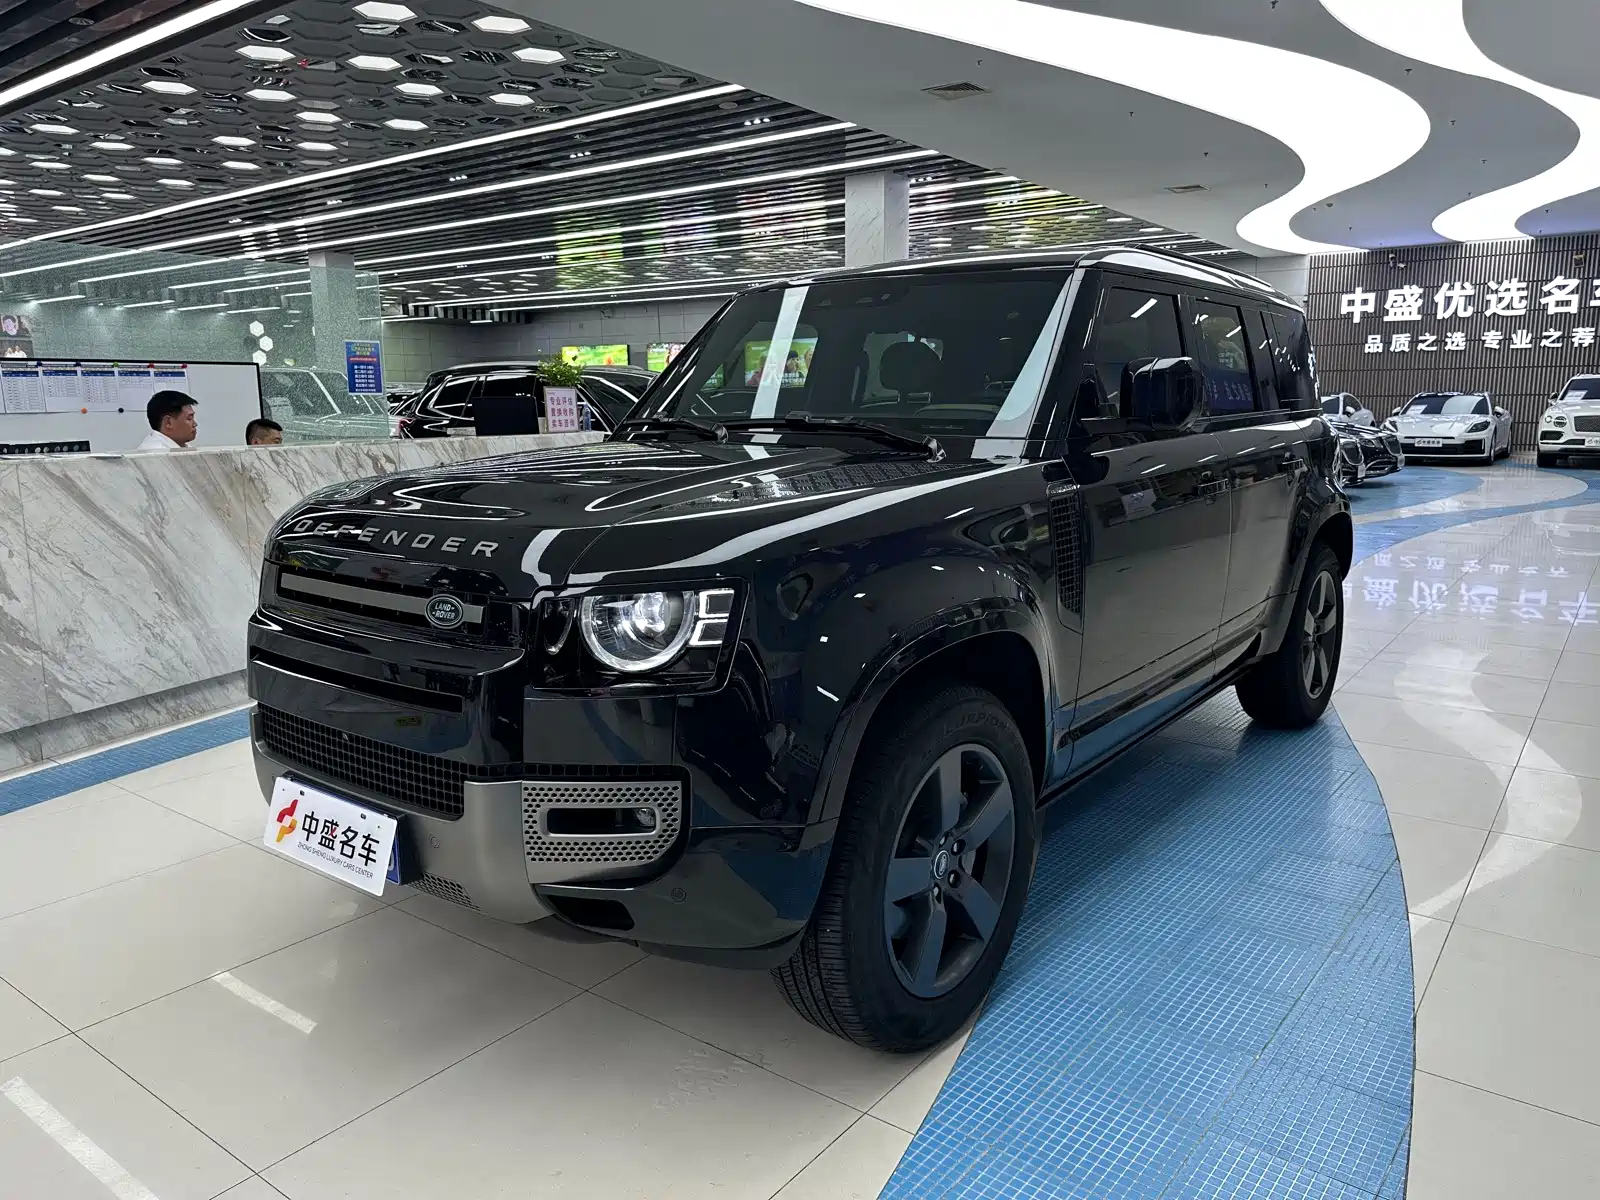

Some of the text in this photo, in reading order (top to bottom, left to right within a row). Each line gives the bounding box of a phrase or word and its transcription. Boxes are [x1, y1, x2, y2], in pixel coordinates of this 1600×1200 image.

[1364, 327, 1595, 353] 品质之选 专业之荐
[550, 396, 573, 406] 专业评估
[551, 407, 574, 417] 置换收购
[293, 518, 499, 558] DEFENDER
[301, 810, 380, 867] 中盛名车
[297, 841, 374, 879] ZHONG SHENG LUXURY CARS CENTER
